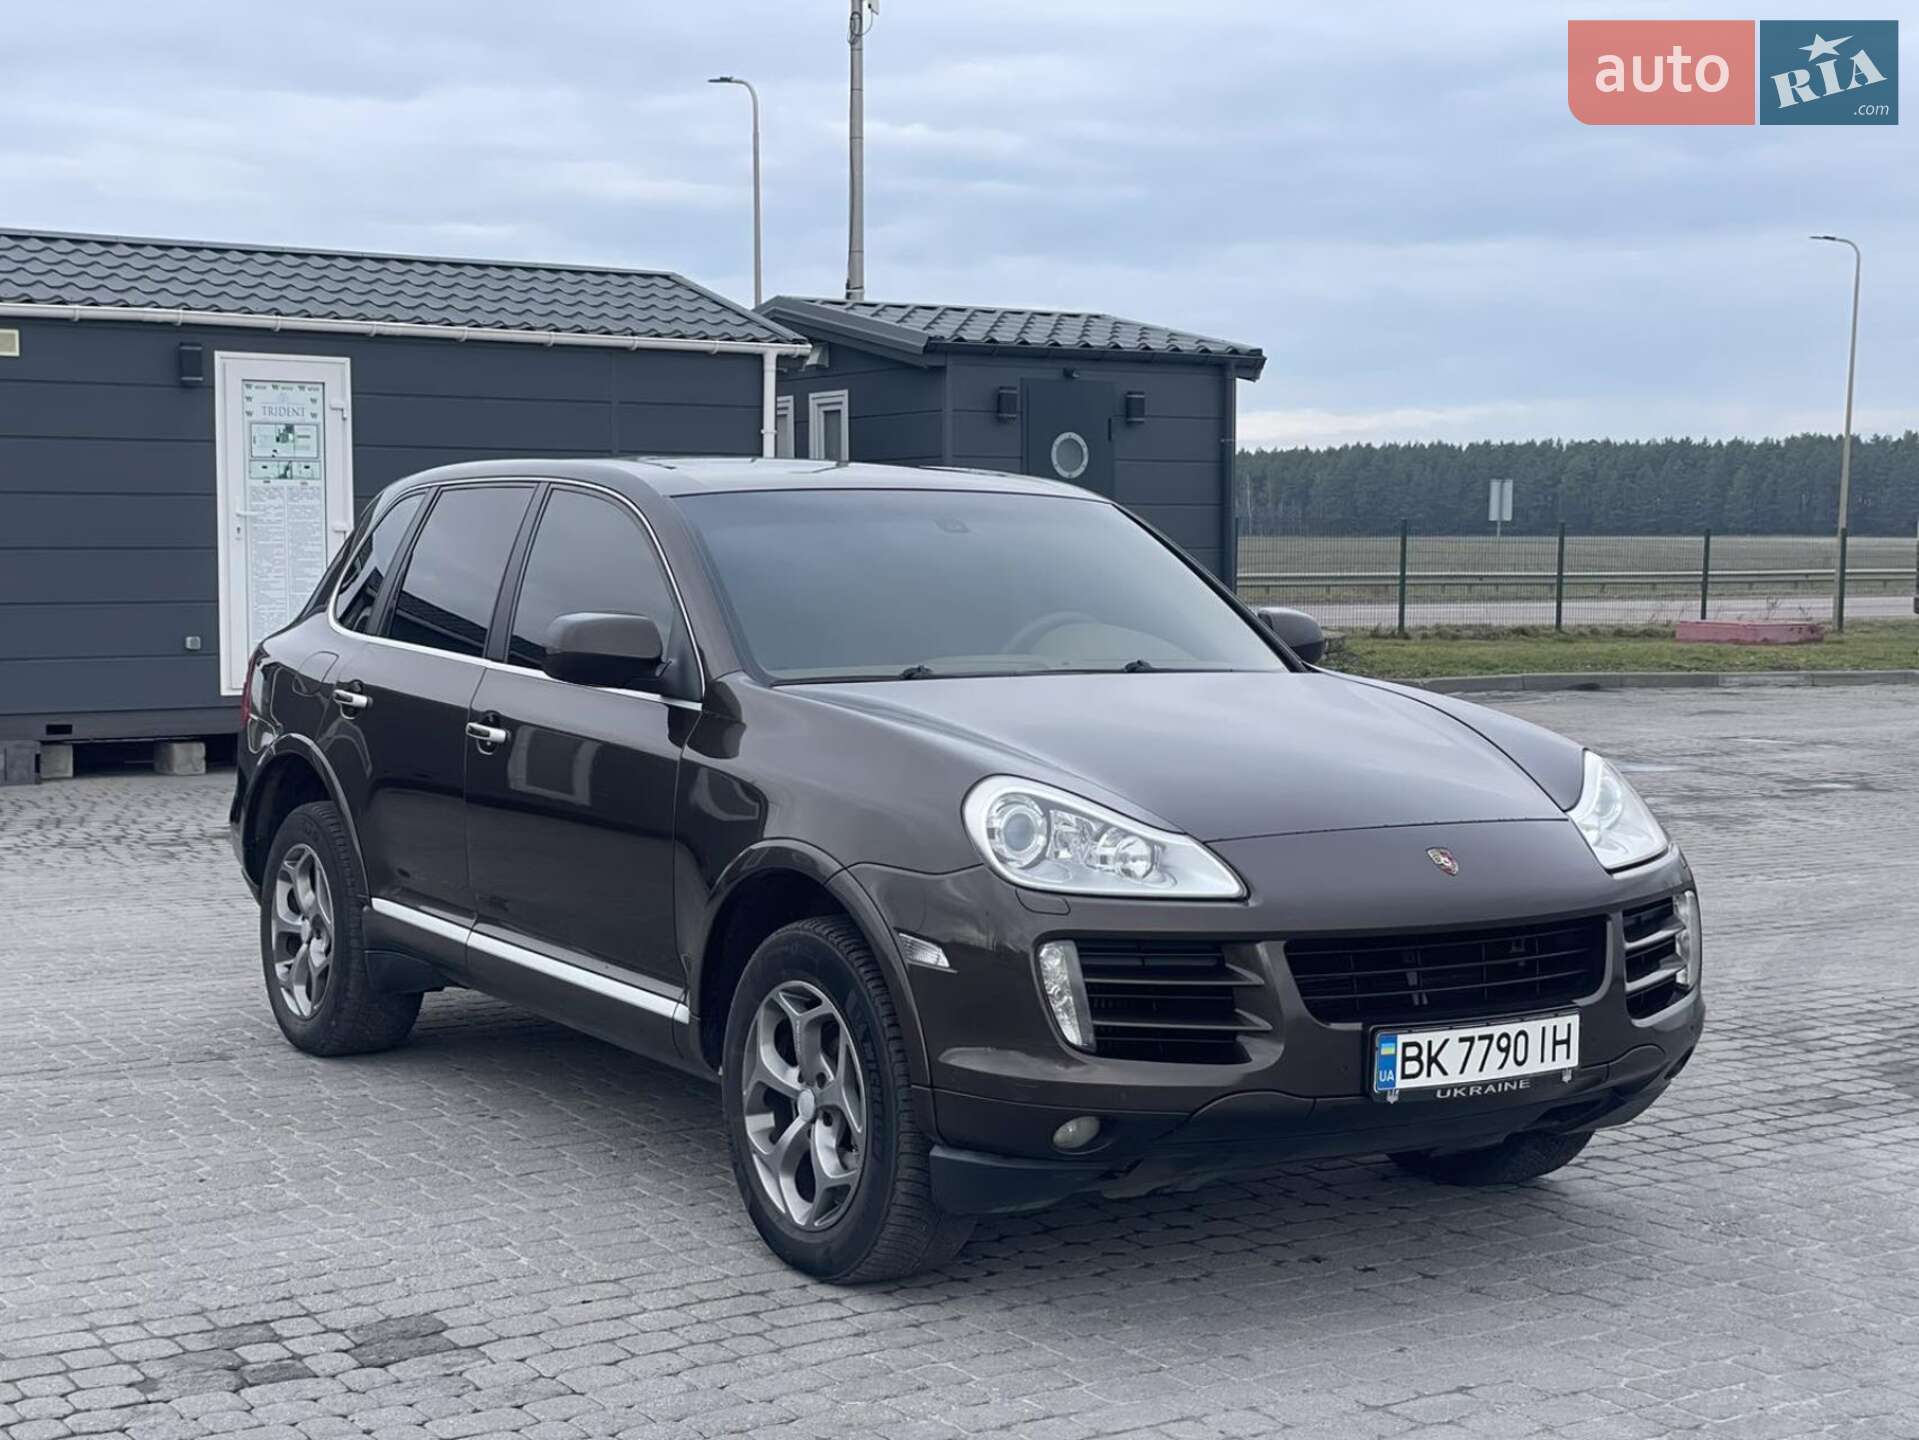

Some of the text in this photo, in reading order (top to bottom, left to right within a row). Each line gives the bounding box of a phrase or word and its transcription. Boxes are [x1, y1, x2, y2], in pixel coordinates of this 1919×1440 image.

[261, 405, 305, 417] TRIDENT
[1400, 1022, 1572, 1080] BK 7790 IH
[1379, 1069, 1395, 1082] UA
[1436, 1078, 1531, 1099] UKRAINE
